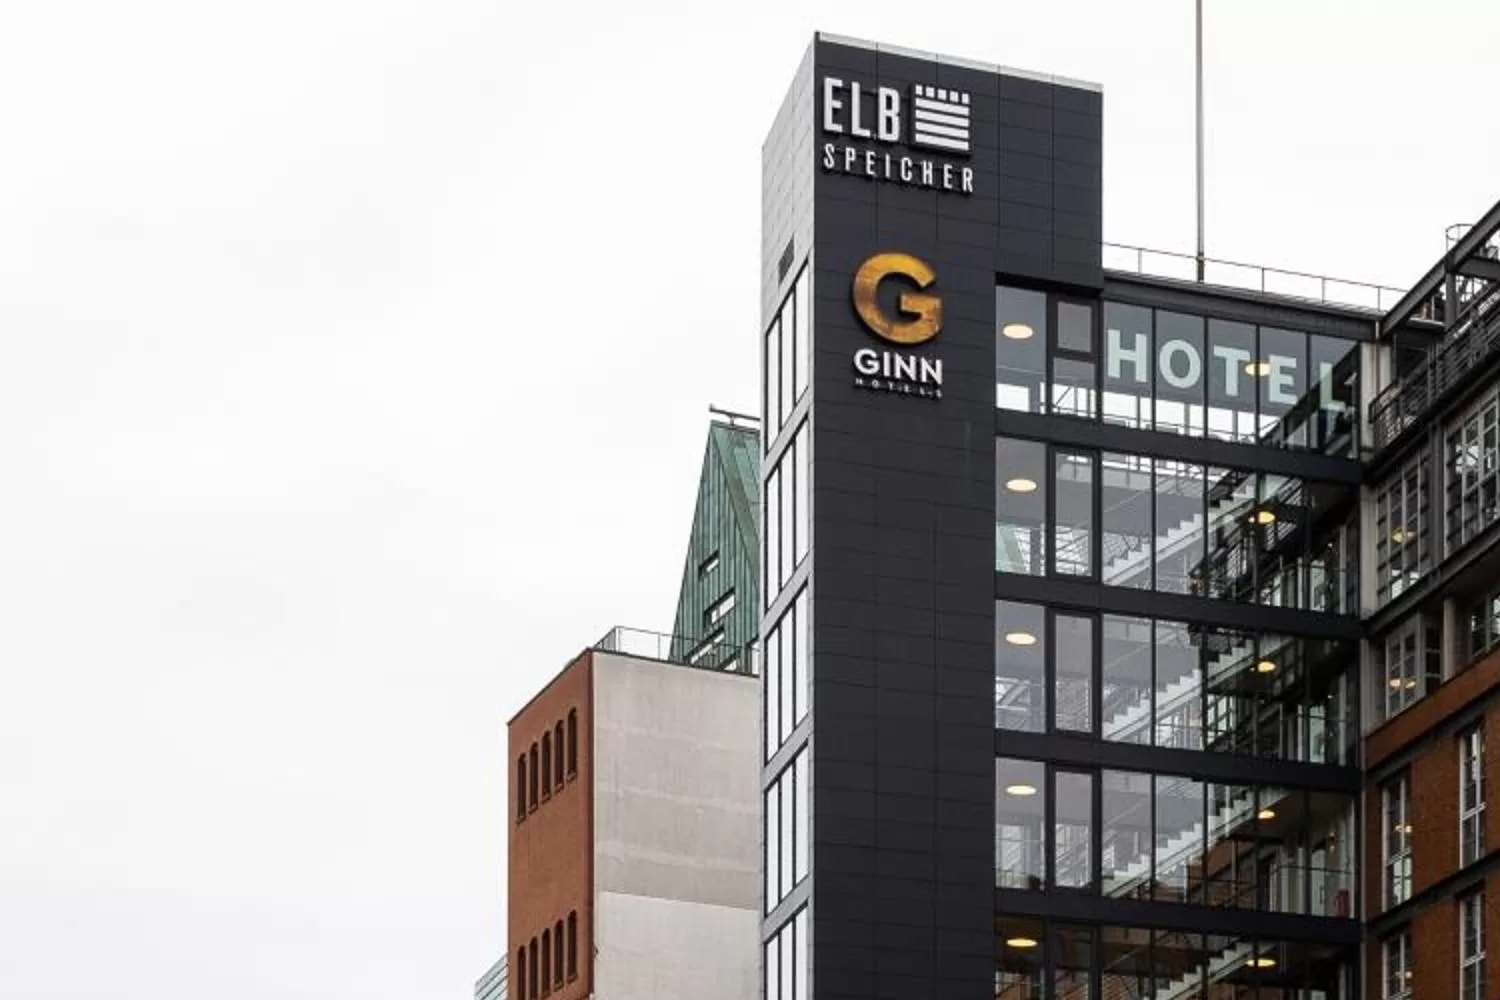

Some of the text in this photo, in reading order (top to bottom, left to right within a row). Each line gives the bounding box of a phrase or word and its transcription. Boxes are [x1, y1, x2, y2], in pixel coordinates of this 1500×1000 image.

[823, 76, 901, 143] ELB
[823, 143, 974, 194] SPEICHER
[852, 251, 943, 345] G
[853, 348, 943, 385] GINN
[1107, 328, 1347, 412] HOTEL
